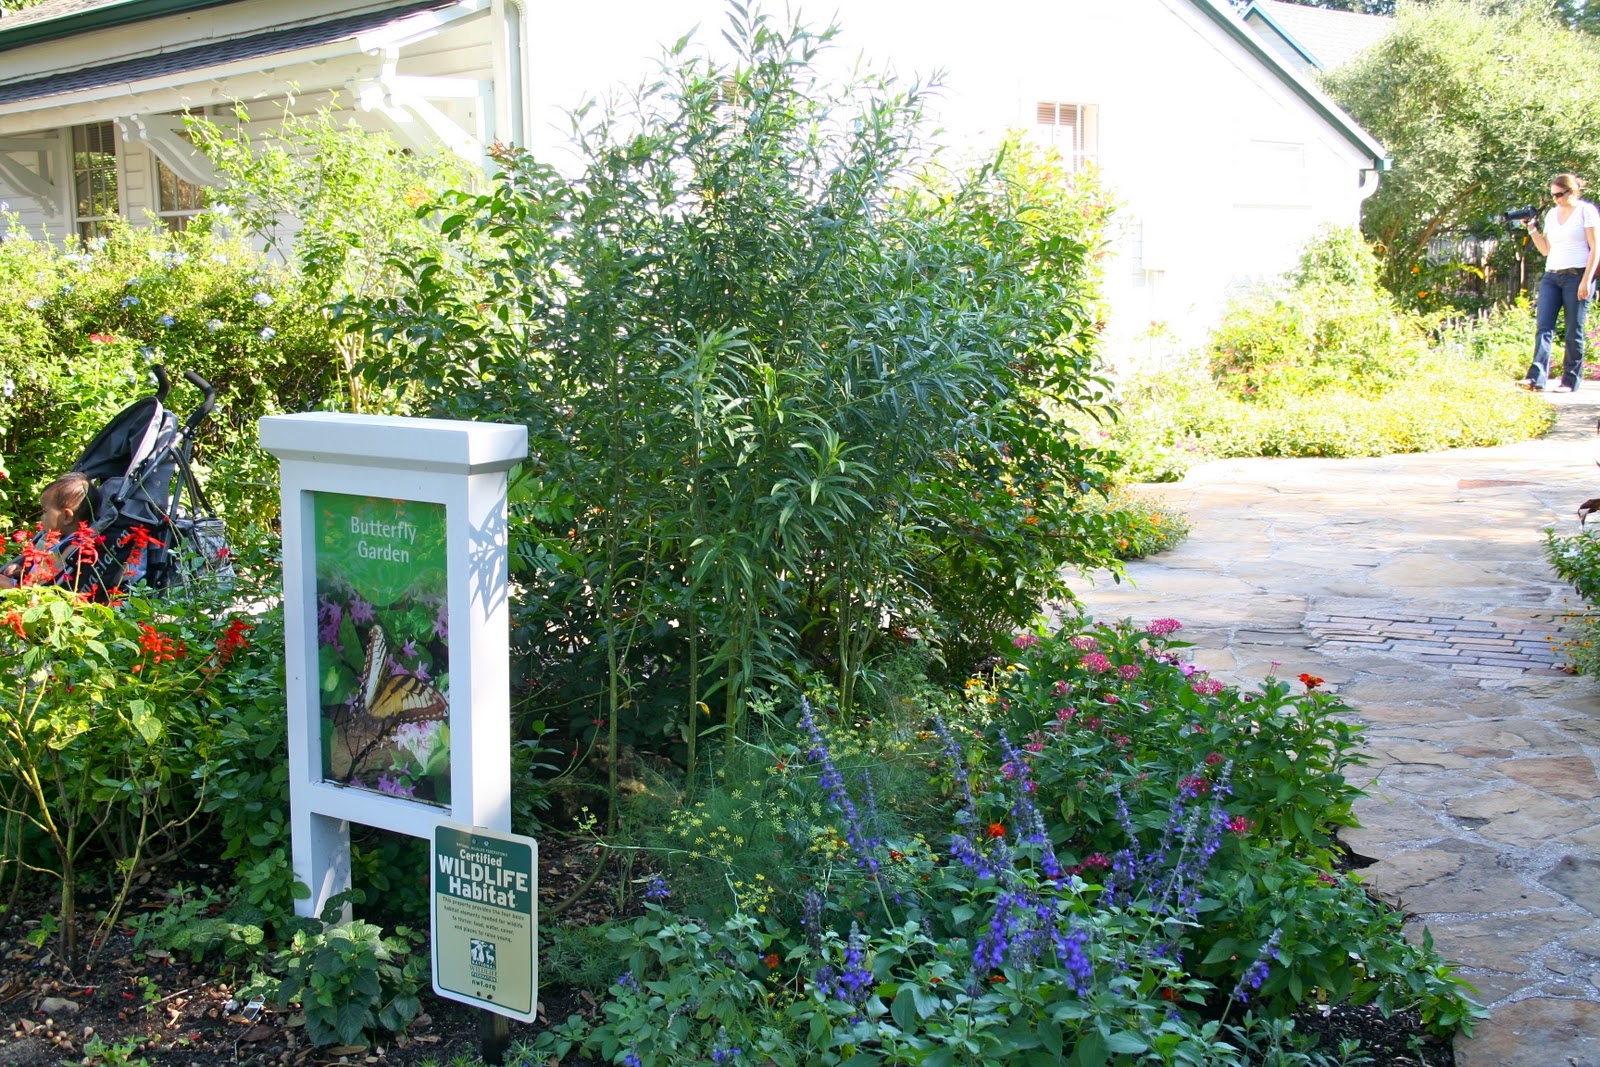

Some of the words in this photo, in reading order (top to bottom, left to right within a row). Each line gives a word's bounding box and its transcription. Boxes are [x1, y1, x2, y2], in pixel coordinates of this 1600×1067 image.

[351, 516, 417, 545] Butterfly
[357, 540, 409, 563] Garden
[459, 849, 502, 868] Certified
[438, 853, 529, 893] WILDLIFE
[449, 875, 516, 909] Habitat
[442, 896, 452, 904] This
[452, 899, 471, 909] property
[472, 904, 491, 913] provides
[512, 913, 525, 921] basic
[444, 905, 459, 913] habitat
[460, 910, 480, 919] elements
[481, 915, 498, 923] needed
[506, 919, 523, 929] wildlife
[463, 926, 478, 935] places
[496, 935, 513, 943] young.
[469, 965, 498, 978] WILDLIFE
[471, 979, 496, 991] nwf.org
